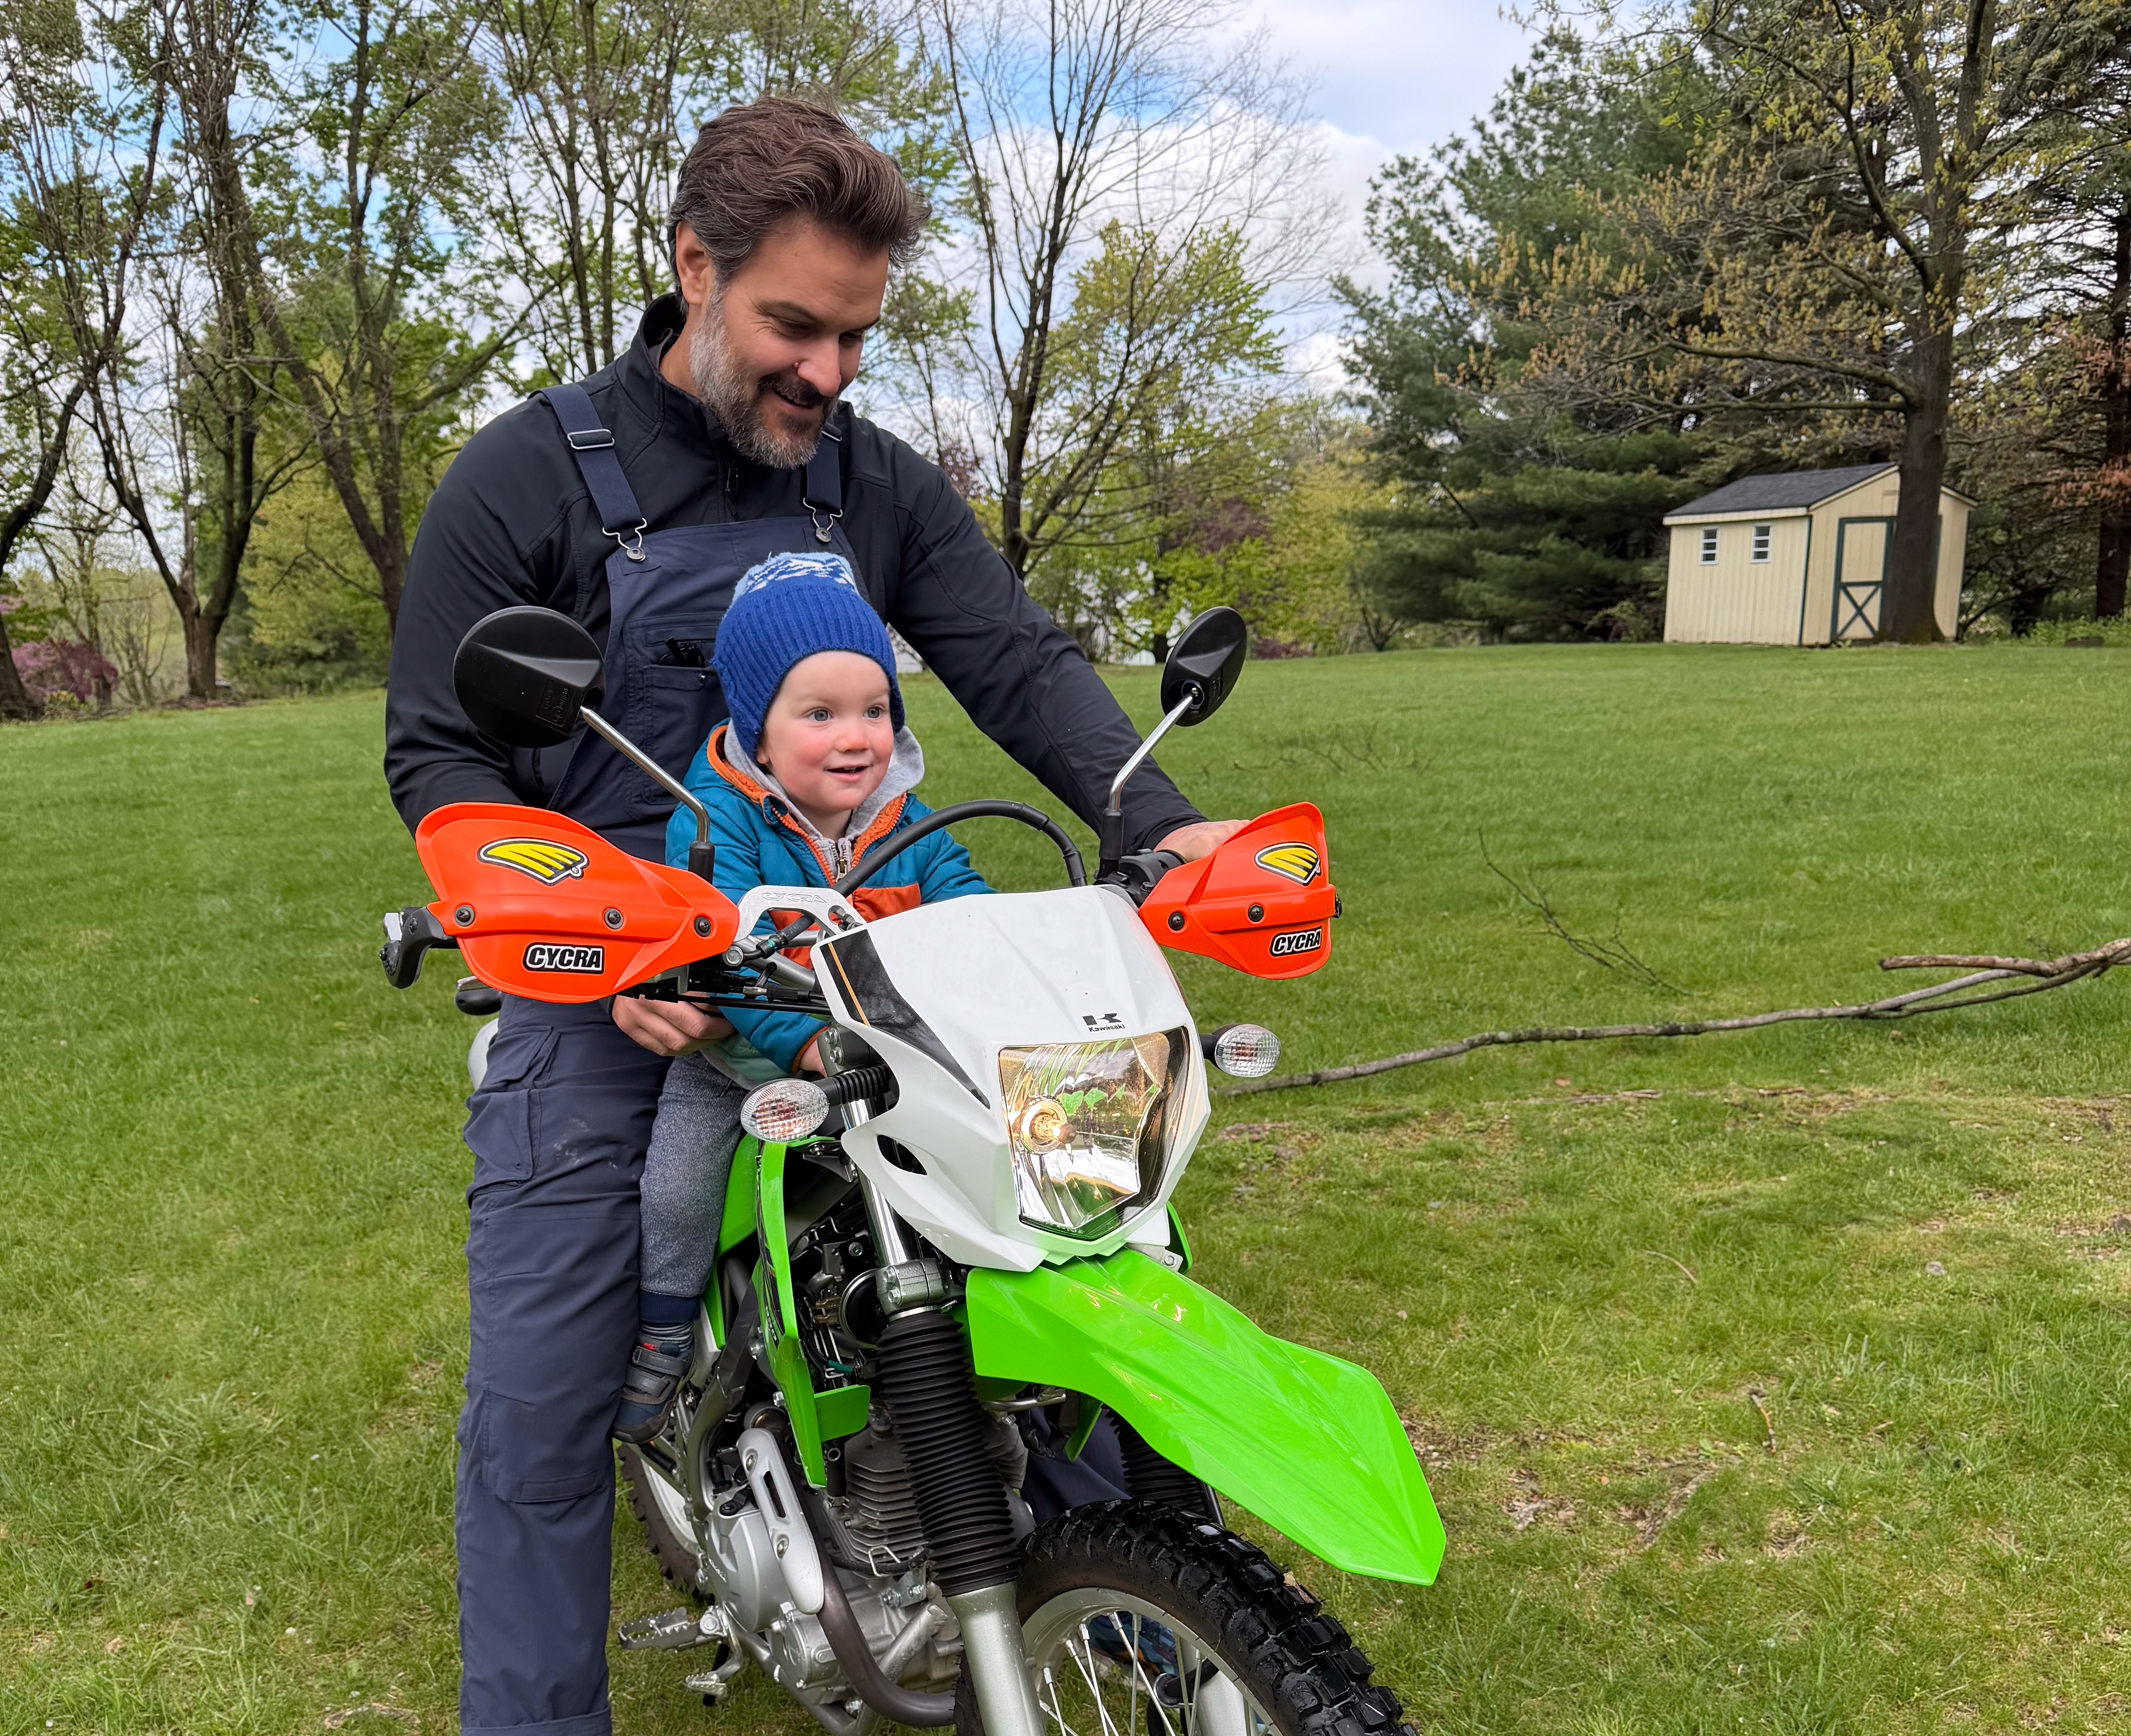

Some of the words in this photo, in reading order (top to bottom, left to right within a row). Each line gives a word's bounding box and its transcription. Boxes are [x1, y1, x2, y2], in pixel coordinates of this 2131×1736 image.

[762, 892, 827, 903] CYCRA
[1273, 930, 1321, 953] CYCRA
[527, 946, 602, 969] CYCRA
[1088, 1024, 1125, 1032] Kawasaki
